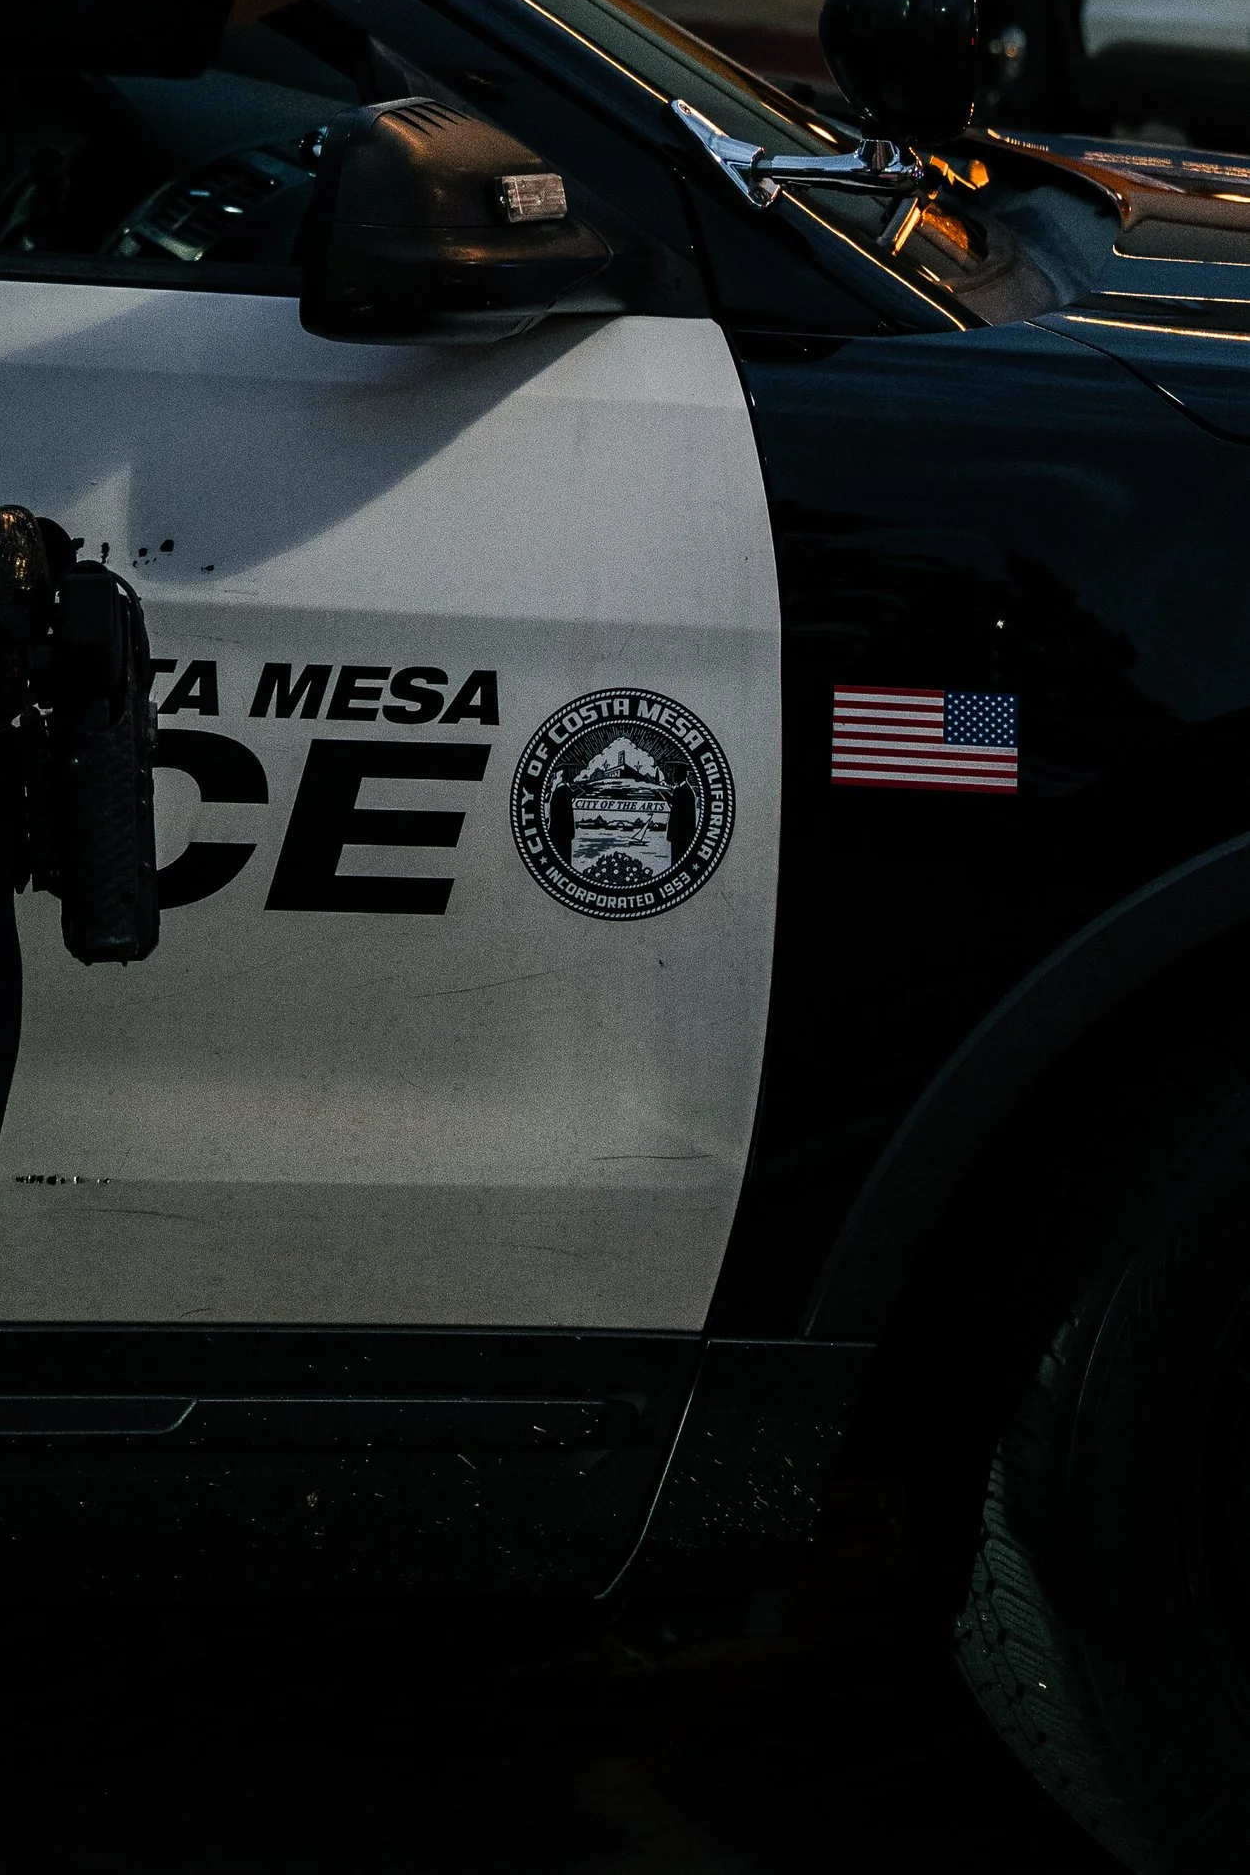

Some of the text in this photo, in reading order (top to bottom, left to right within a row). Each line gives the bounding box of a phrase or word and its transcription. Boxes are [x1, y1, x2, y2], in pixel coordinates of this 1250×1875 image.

[249, 662, 500, 726] MESA
[521, 698, 704, 854] CITY OF COSTA MESA
[575, 799, 665, 811] CITY OF THE ARTS
[697, 751, 724, 861] CALIFORNIA
[545, 865, 692, 909] INCORPORATED 1953
